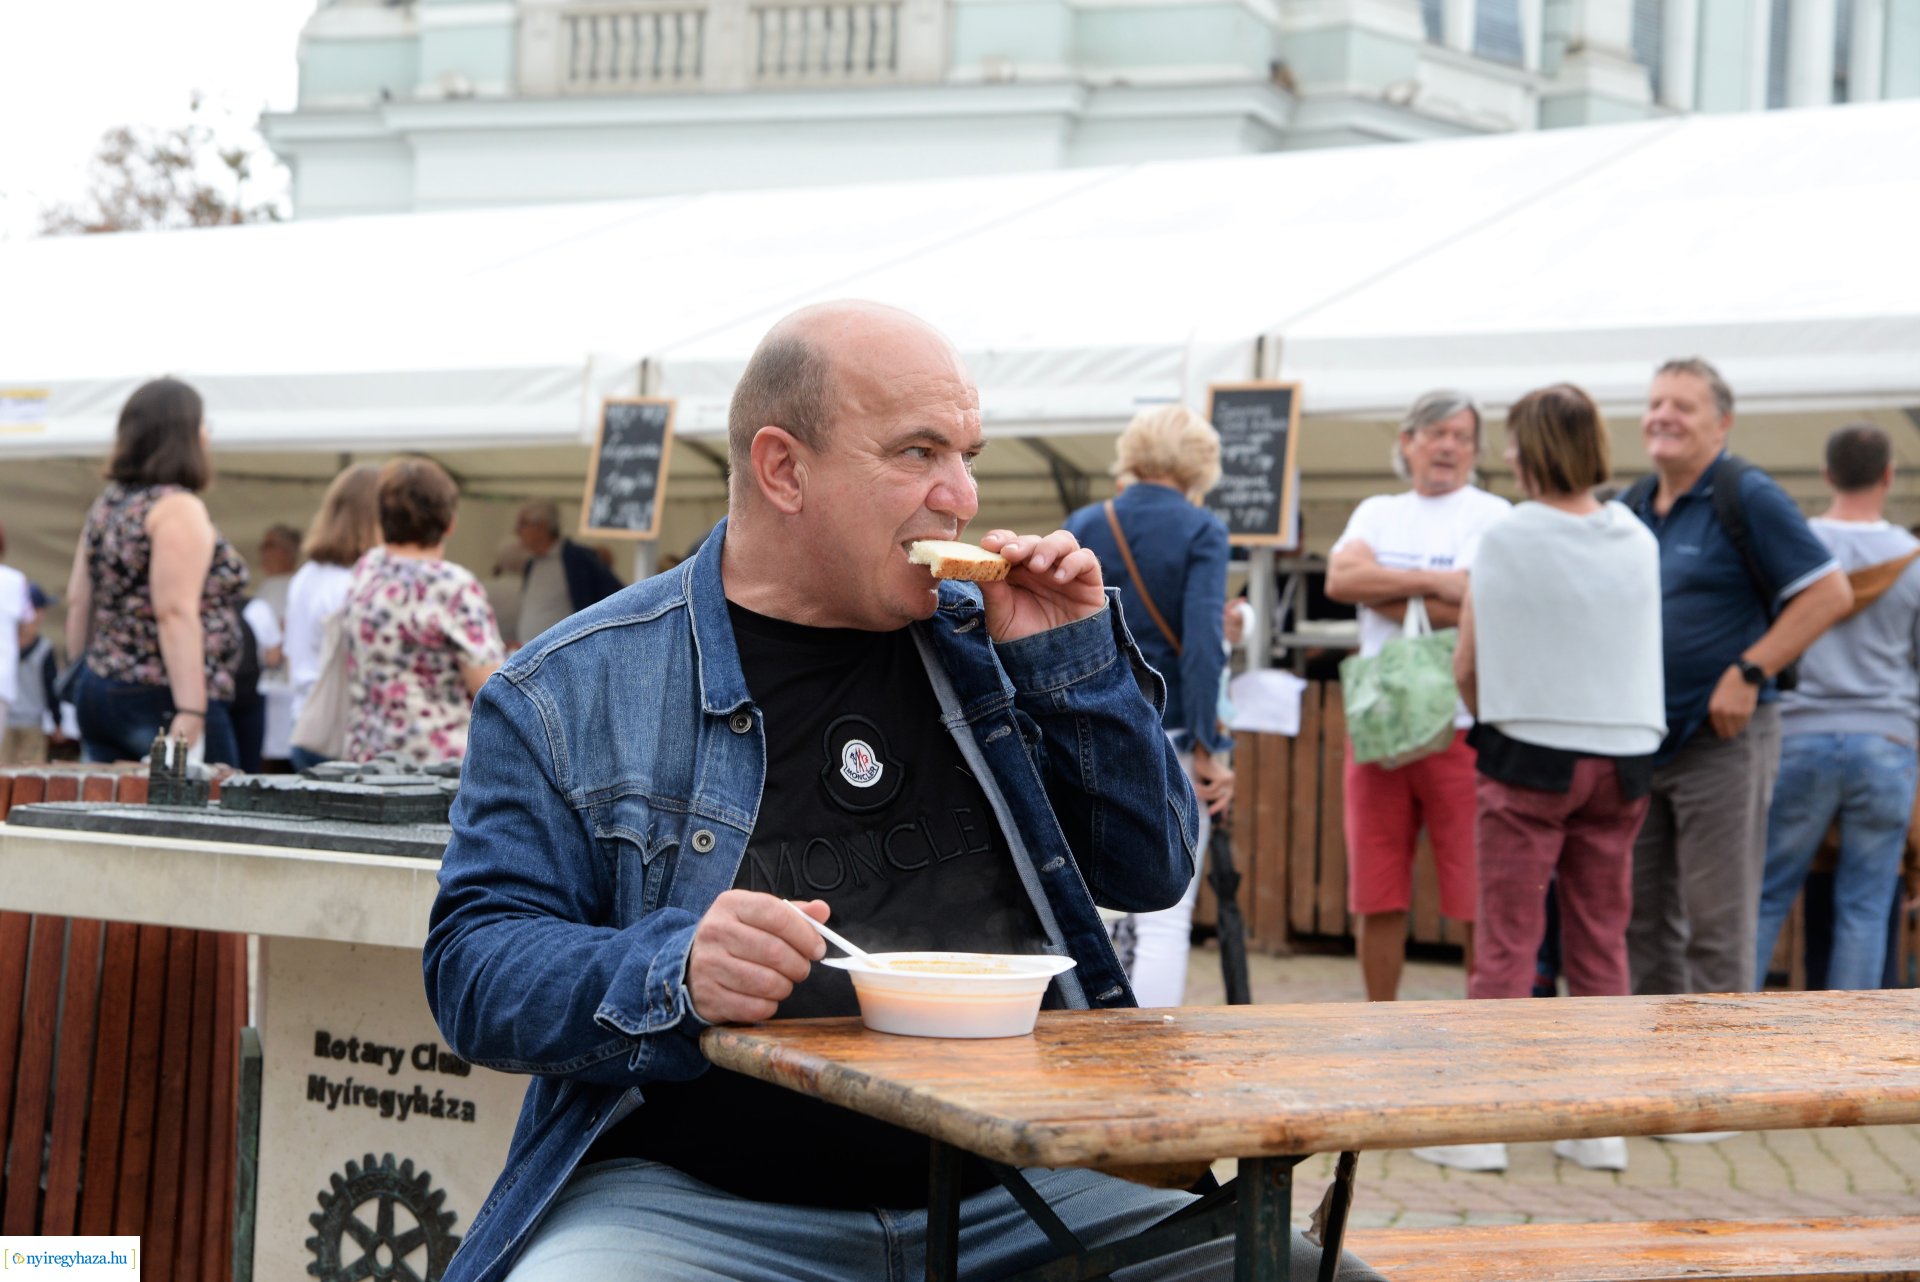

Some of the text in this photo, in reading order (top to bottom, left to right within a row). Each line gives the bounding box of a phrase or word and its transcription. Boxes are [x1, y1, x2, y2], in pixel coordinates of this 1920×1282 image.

[846, 765, 877, 781] MONCLER
[747, 807, 991, 897] MONCLE
[314, 1030, 405, 1075] Rotary
[307, 1073, 476, 1122] Nyíregyháza
